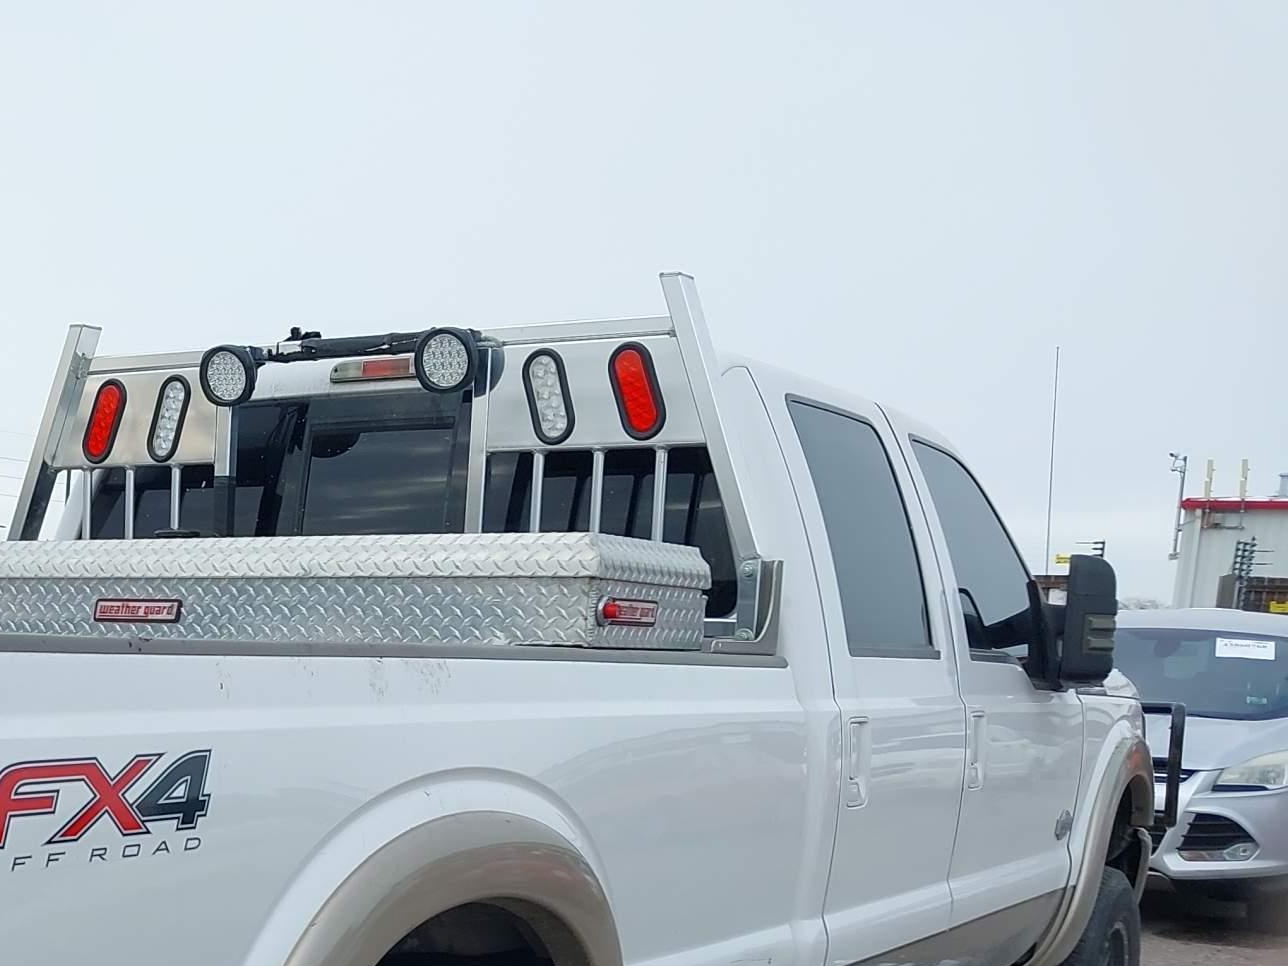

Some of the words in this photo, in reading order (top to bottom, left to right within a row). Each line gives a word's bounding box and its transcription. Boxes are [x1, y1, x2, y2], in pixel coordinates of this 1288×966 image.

[99, 603, 141, 615] weather
[143, 603, 174, 616] guard
[89, 837, 202, 863] ROAD
